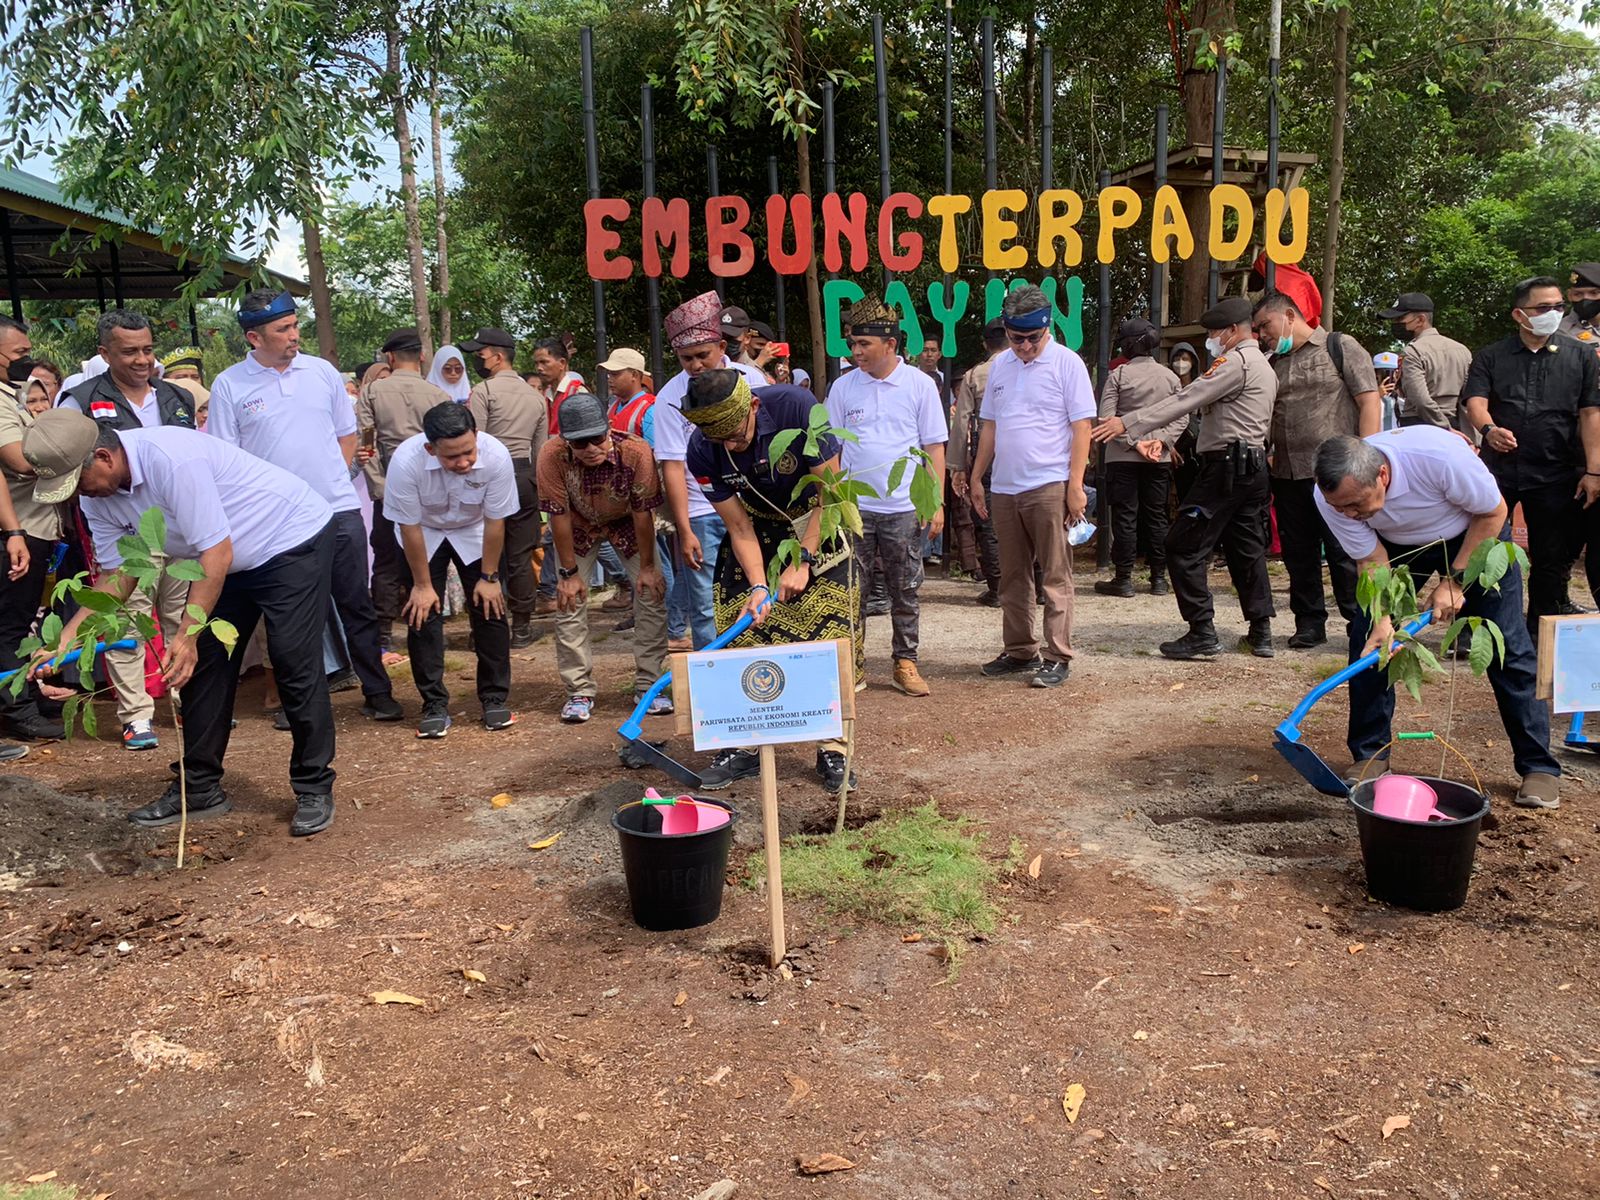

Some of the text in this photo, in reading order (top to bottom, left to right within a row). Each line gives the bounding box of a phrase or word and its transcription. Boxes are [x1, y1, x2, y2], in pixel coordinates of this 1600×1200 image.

[583, 183, 1310, 281] EMBUNG TERPADU
[242, 397, 264, 410] ADWI
[750, 705, 784, 714] MENTERI
[699, 716, 746, 726] PARIWISATA
[764, 711, 800, 721] EKONOMI
[801, 708, 834, 718] KREATIF
[728, 719, 808, 732] REPUBLIK INDONESIA
